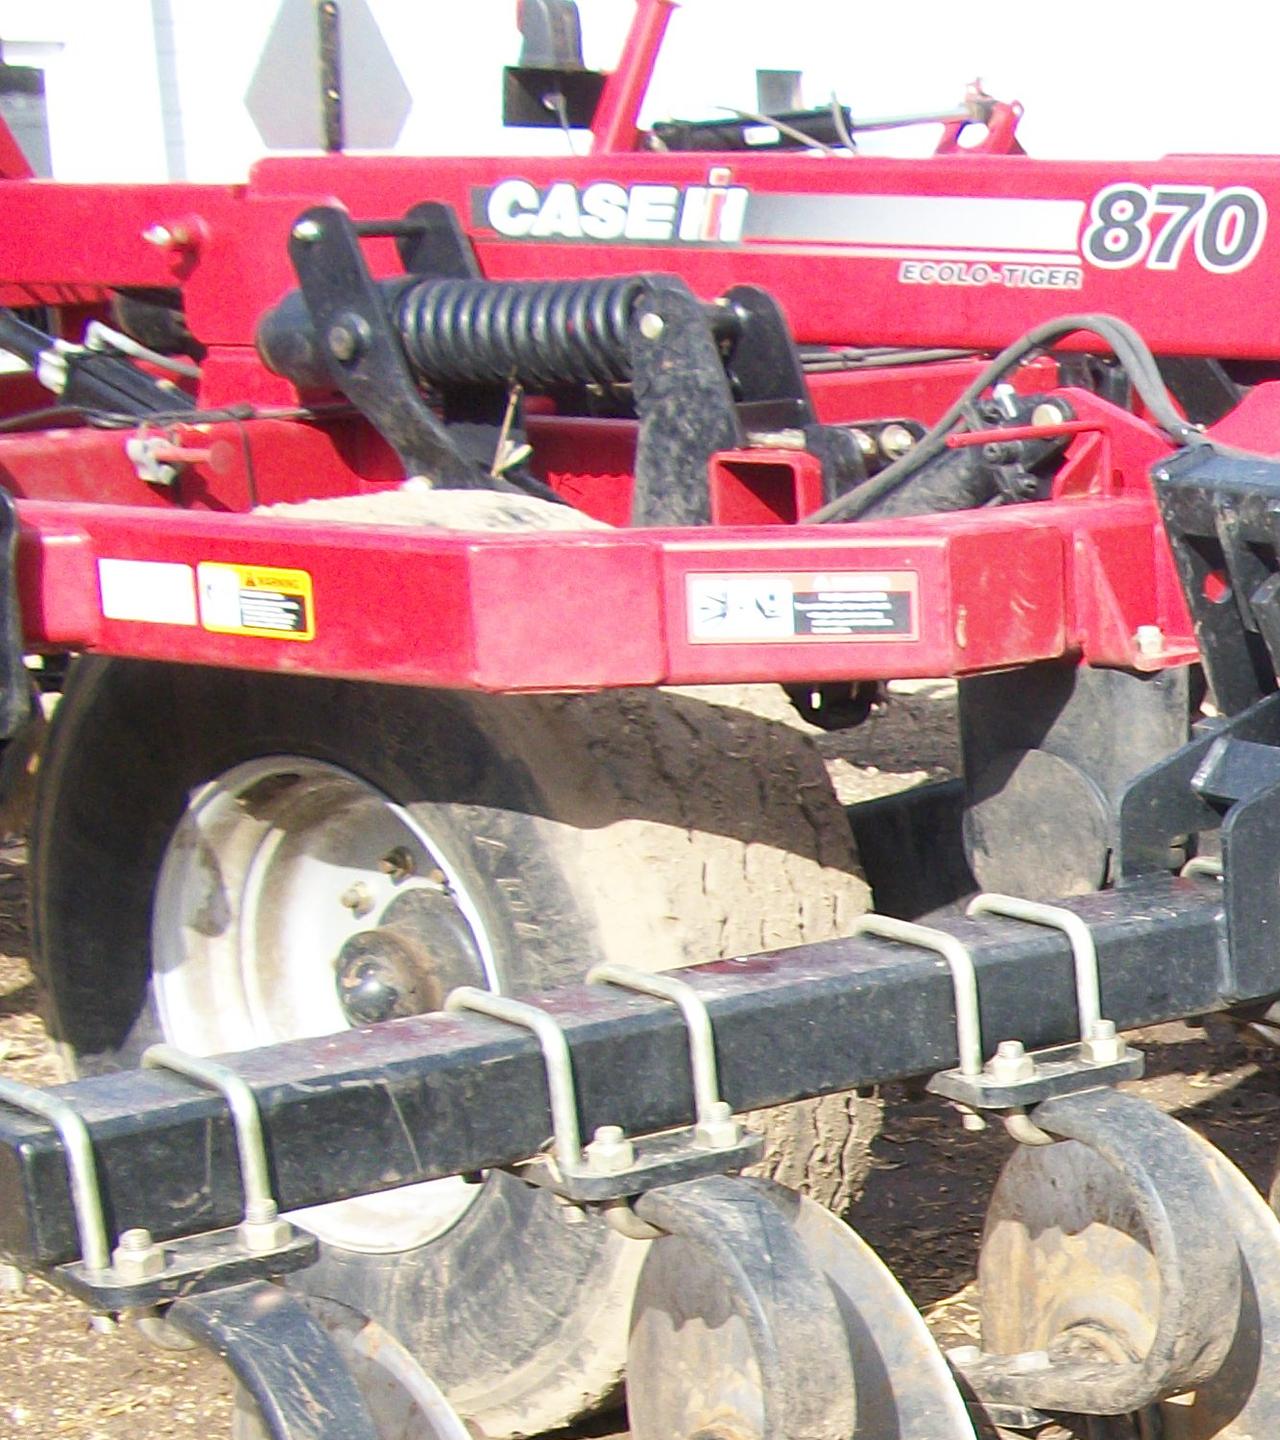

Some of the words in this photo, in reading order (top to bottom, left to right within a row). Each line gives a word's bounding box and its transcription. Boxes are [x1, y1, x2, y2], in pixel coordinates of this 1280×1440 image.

[487, 177, 679, 240] CASE
[1084, 184, 1265, 272] 870
[902, 264, 1081, 288] ECOLO-TIGER
